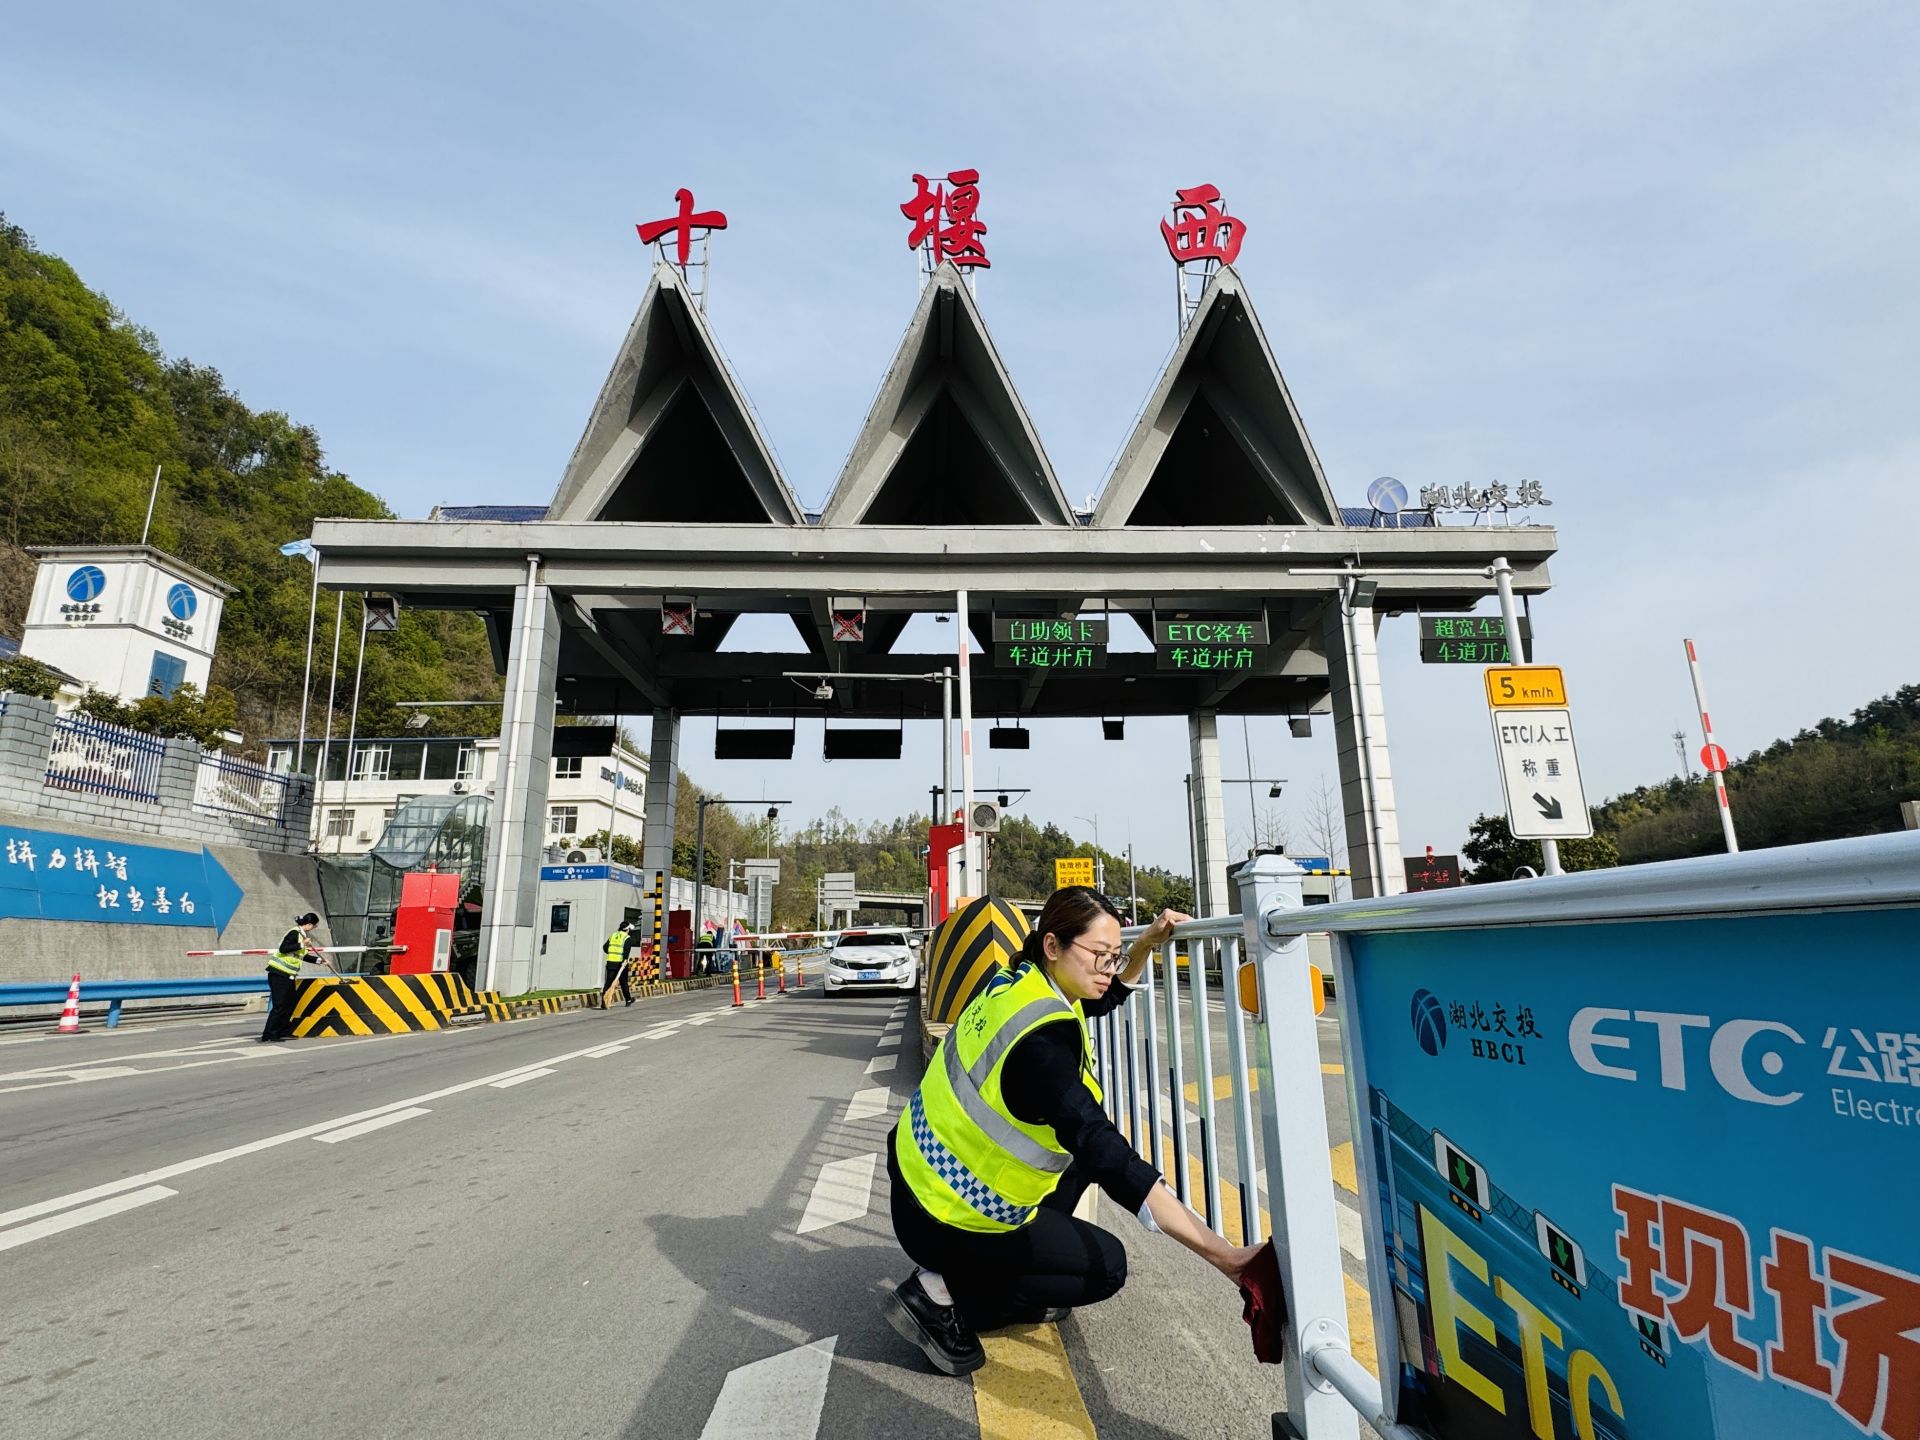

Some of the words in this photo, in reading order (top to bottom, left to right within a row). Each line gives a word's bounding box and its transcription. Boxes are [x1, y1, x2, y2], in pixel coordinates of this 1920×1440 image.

[636, 168, 1247, 269] 十堰西
[1420, 479, 1553, 509] 湖北交投
[1010, 621, 1094, 641] 自助领卡
[1168, 623, 1253, 642] ETC客车
[1010, 646, 1093, 667] 车道开启
[1172, 648, 1253, 669] 车道开启
[1500, 676, 1515, 699] 5
[1522, 687, 1554, 698] km/h
[1501, 724, 1569, 744] ETC/人工
[1522, 758, 1562, 778] 称重
[6, 838, 128, 881] 拼力拼智
[96, 884, 196, 915] 担当善为
[1449, 1000, 1543, 1039] 湖北交投
[1470, 1038, 1526, 1065] HBCI
[1569, 1007, 1806, 1106] ETC
